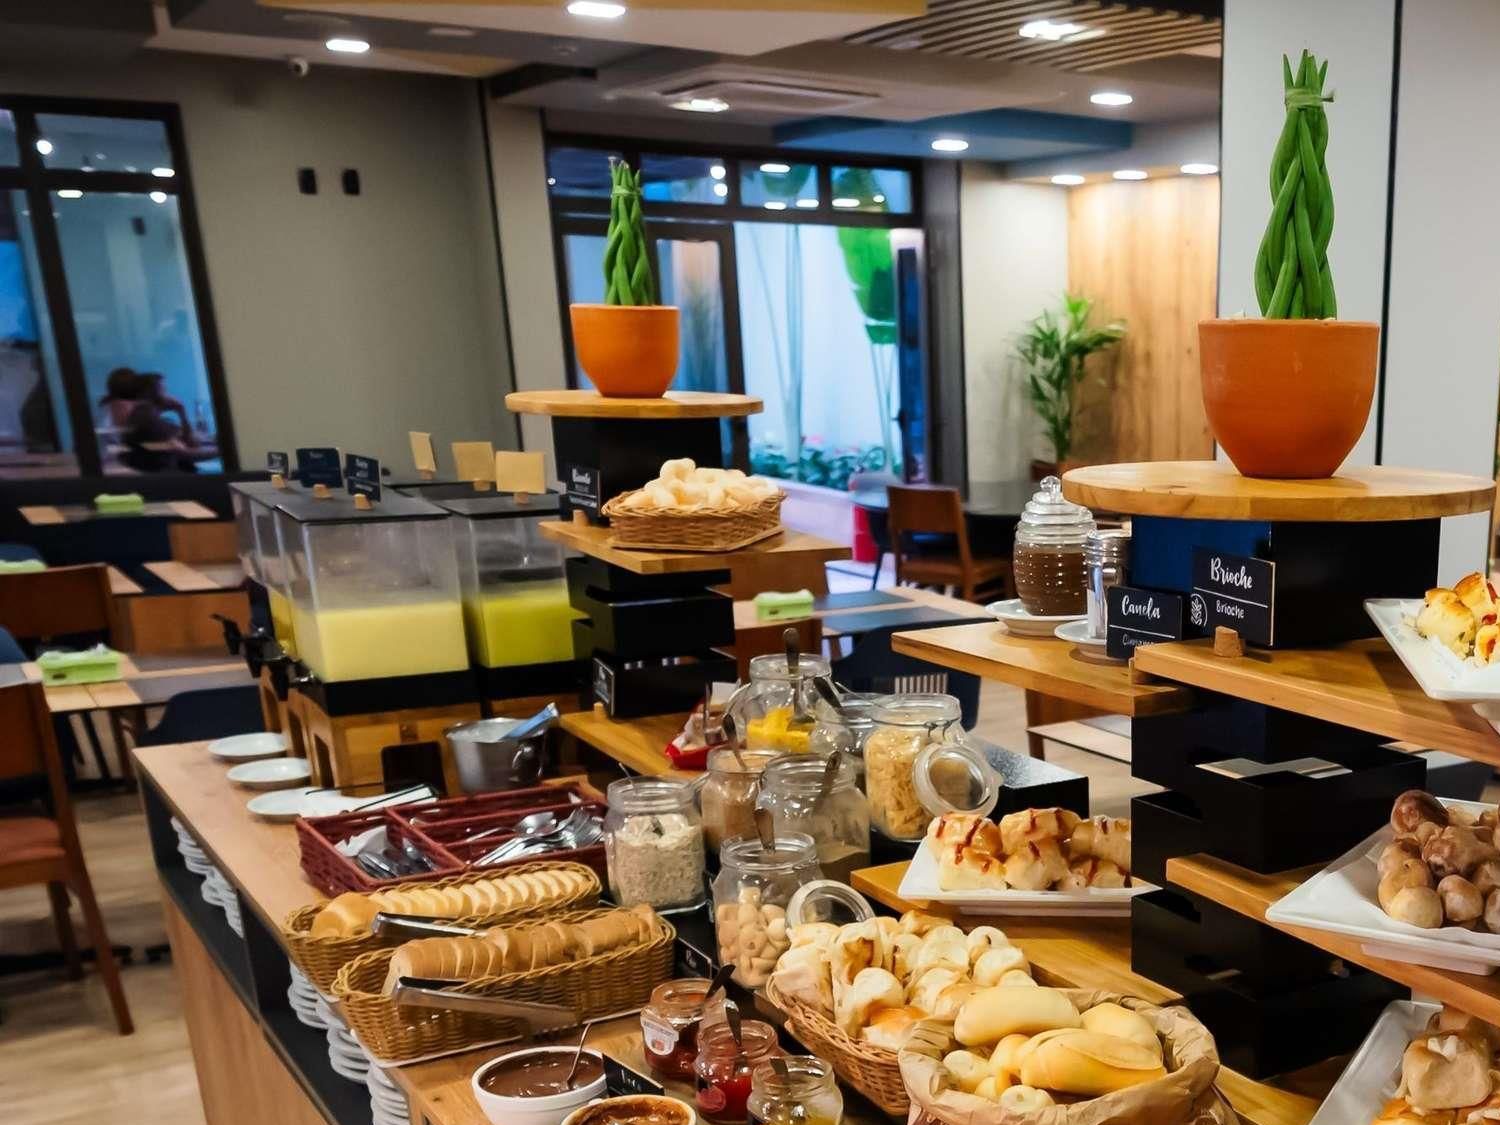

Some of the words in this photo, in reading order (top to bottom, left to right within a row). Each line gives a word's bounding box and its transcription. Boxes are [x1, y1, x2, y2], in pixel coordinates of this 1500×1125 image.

[1210, 557, 1253, 590] Brioche
[1121, 594, 1161, 620] Canela
[1215, 599, 1245, 619] Brioche
